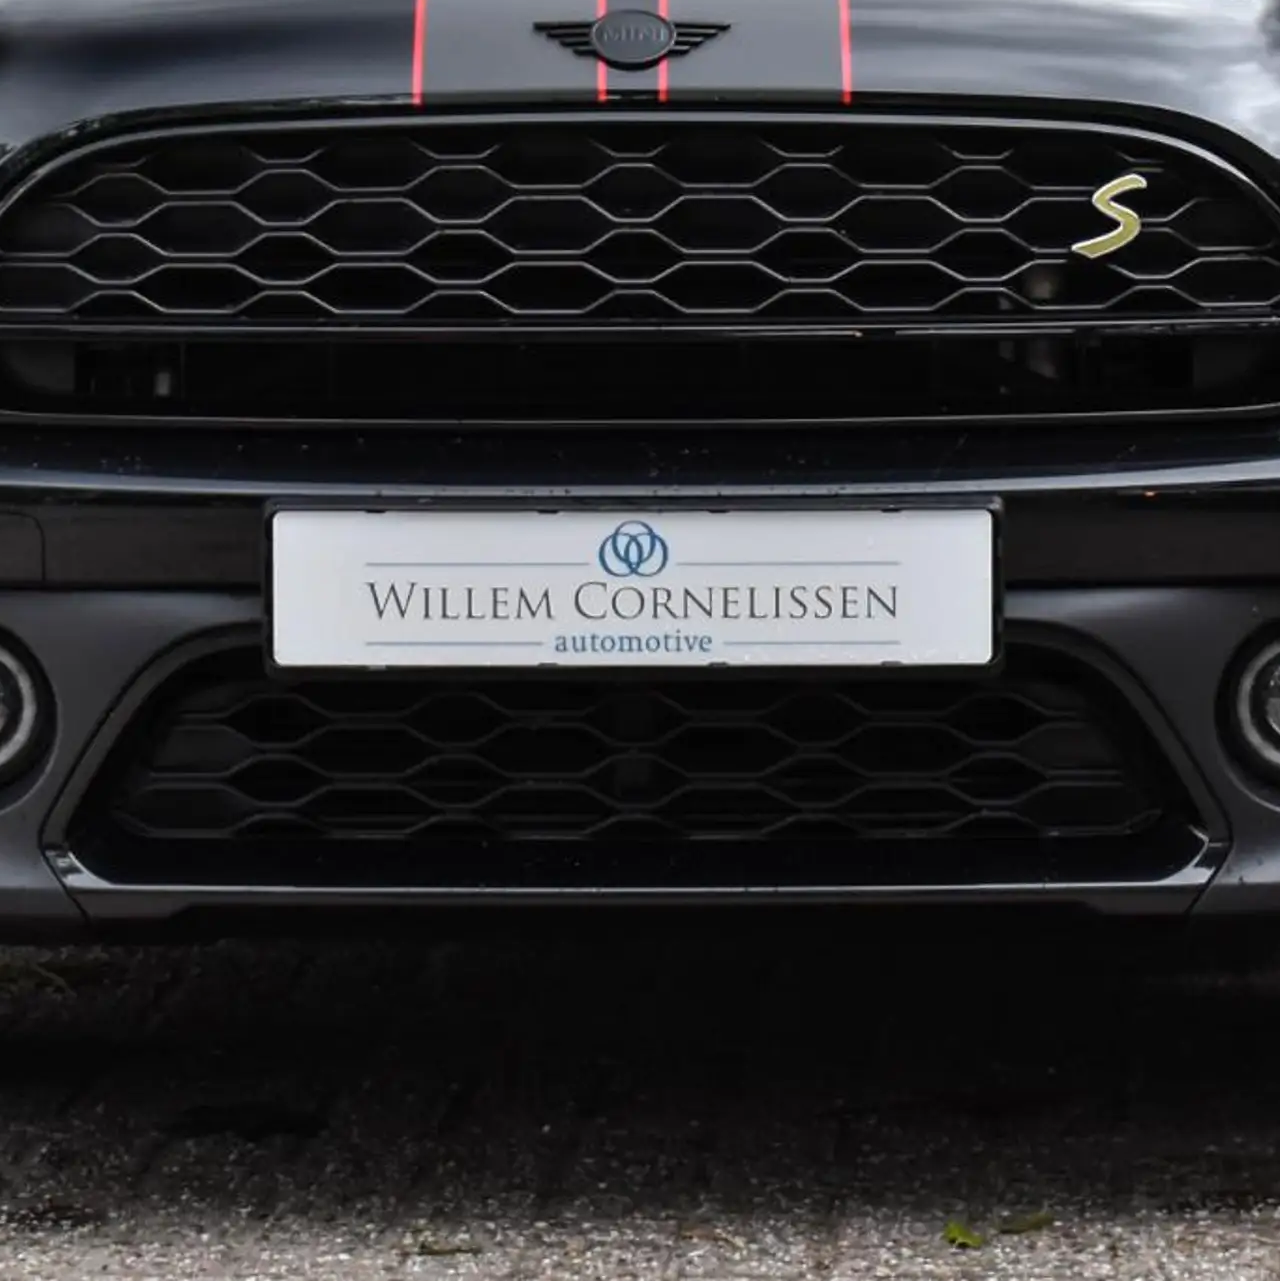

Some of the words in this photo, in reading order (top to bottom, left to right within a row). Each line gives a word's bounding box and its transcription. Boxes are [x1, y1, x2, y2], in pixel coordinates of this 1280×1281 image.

[602, 23, 666, 42] MINI
[1072, 174, 1147, 259] S
[366, 581, 556, 620] WILLEM
[574, 581, 898, 620] CORNELISSEN
[554, 630, 713, 653] automotive
